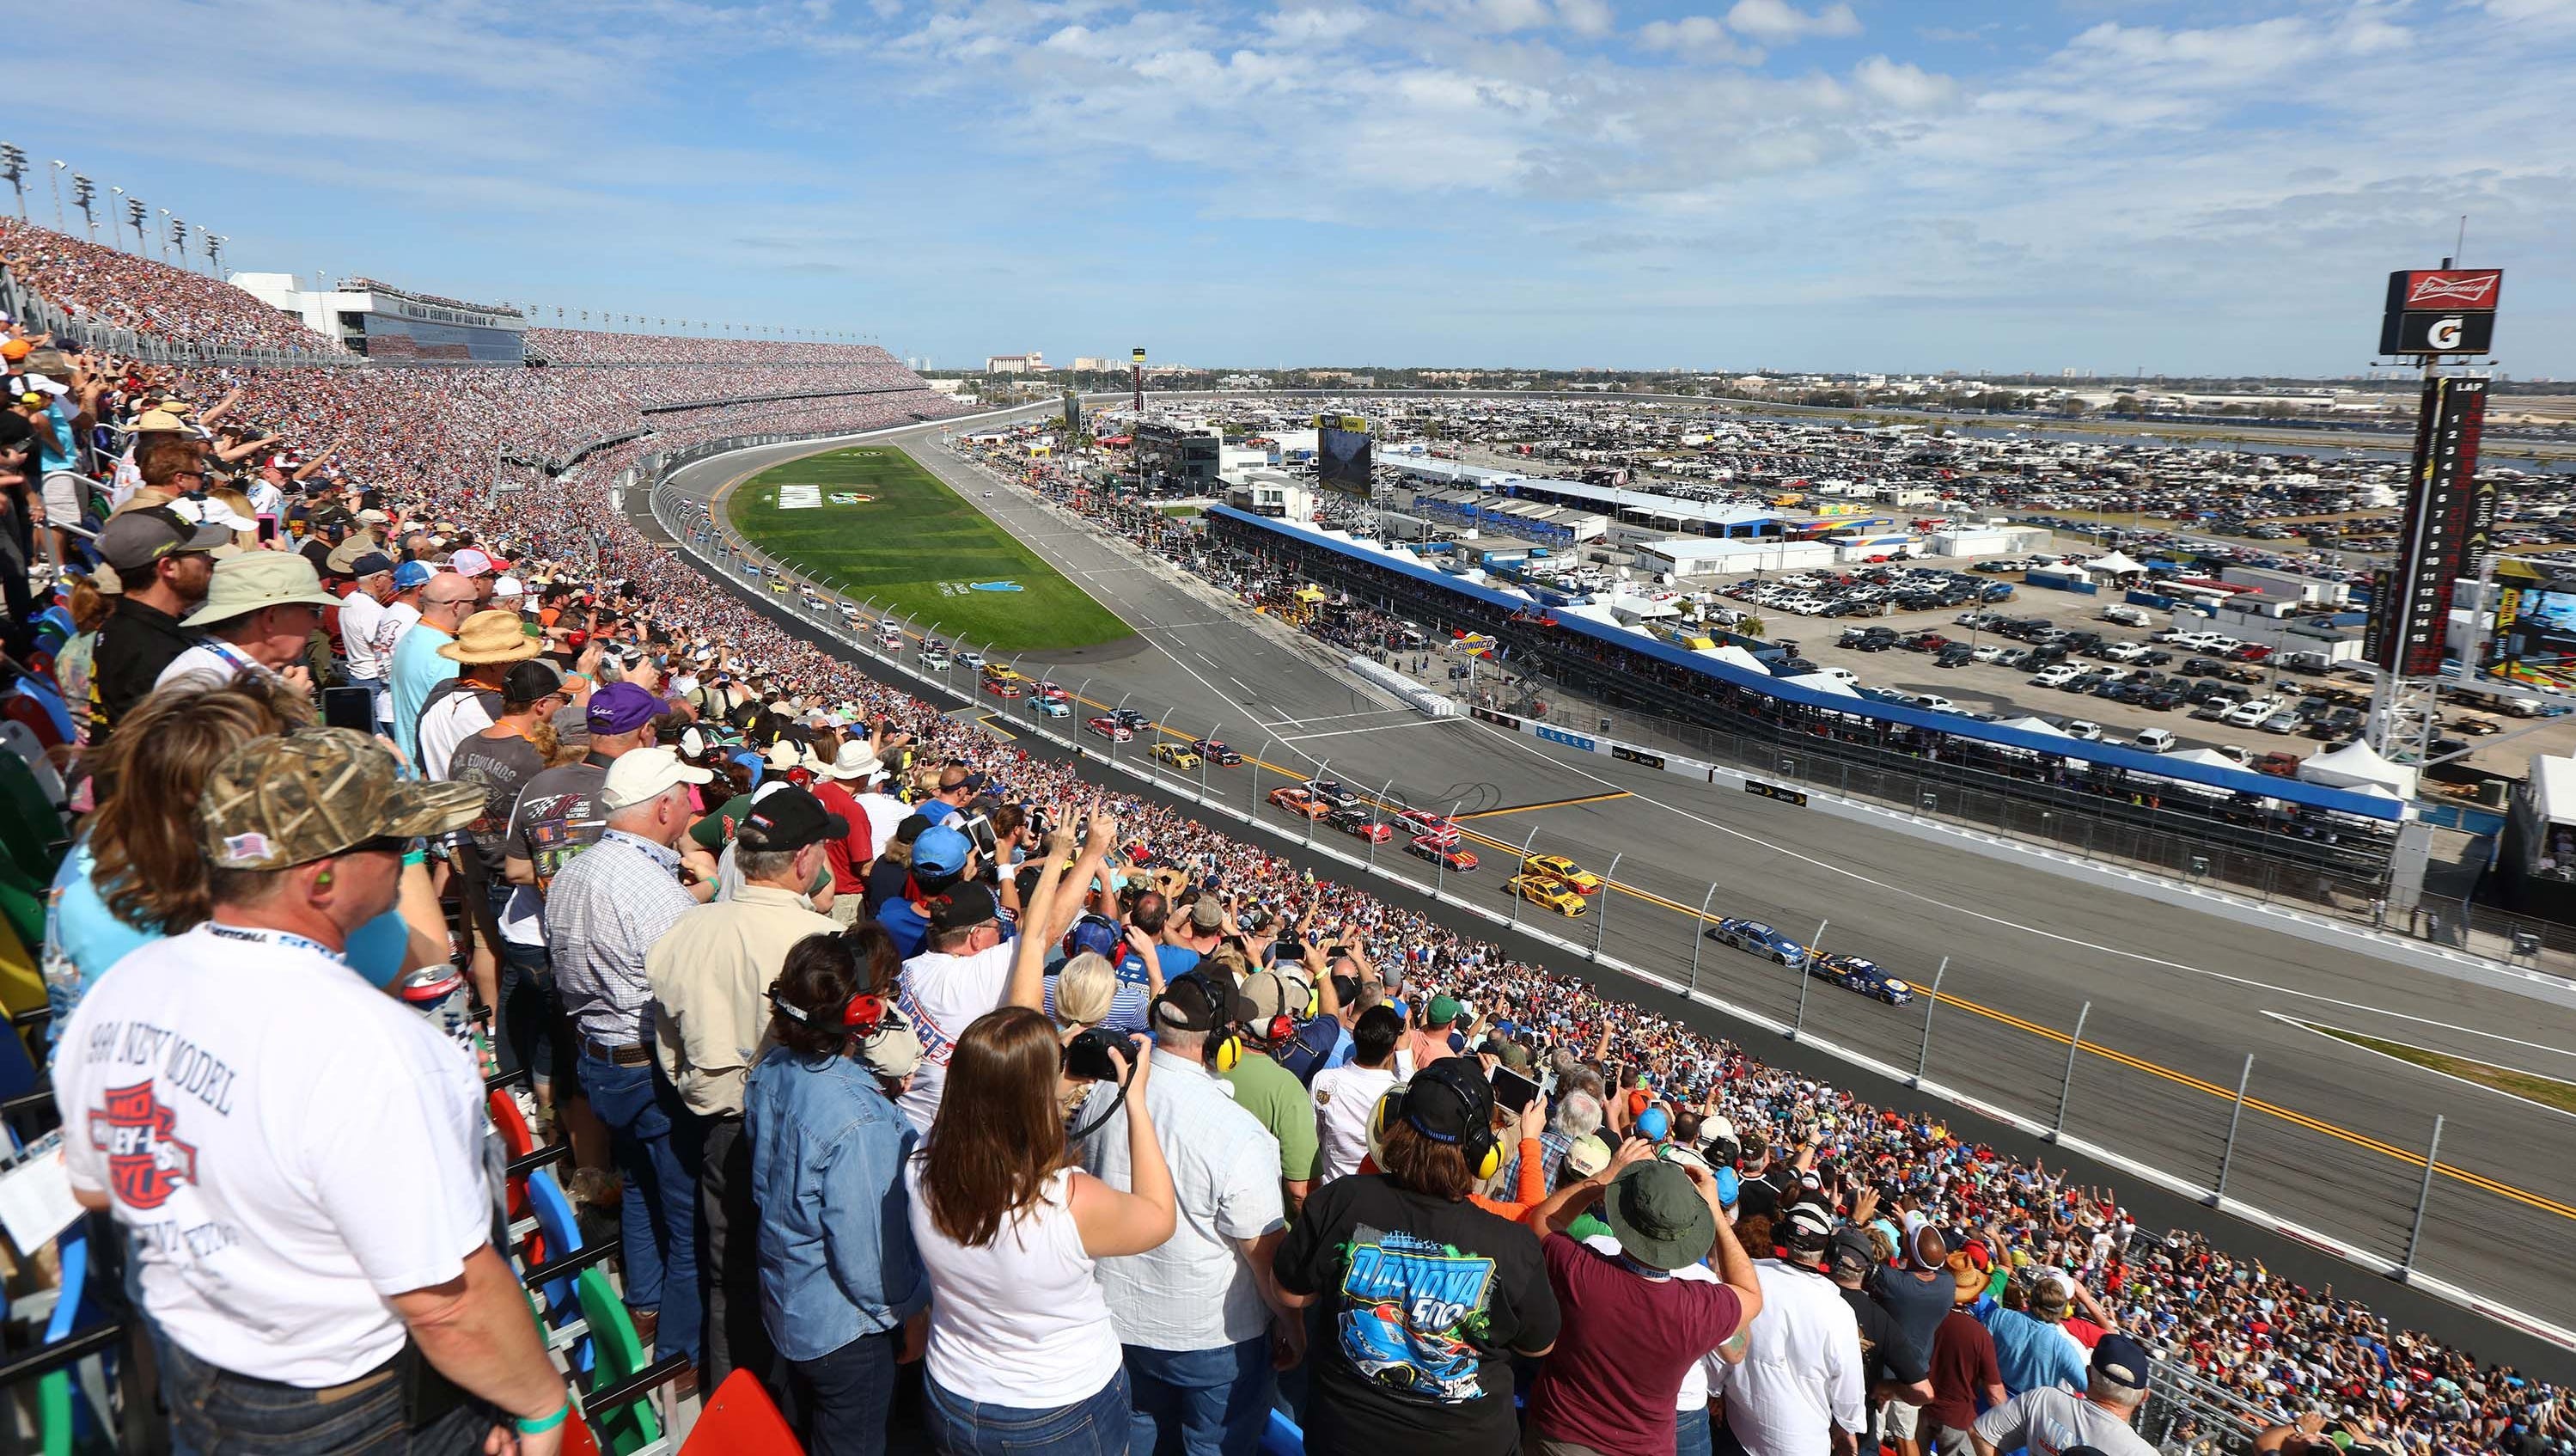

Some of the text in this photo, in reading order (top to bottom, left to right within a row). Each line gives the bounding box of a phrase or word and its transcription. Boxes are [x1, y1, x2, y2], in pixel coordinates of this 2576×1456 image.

[430, 309, 453, 321] CENTER
[464, 315, 486, 326] RACING
[2427, 315, 2463, 349] G
[2456, 382, 2483, 392] LAP
[2451, 414, 2459, 423] 1
[2447, 431, 2457, 439] 2
[2445, 446, 2455, 456] 3
[2442, 462, 2453, 471] 4
[2440, 478, 2450, 486] 5
[2437, 494, 2447, 503] 6
[2435, 510, 2445, 518] 7
[2474, 496, 2493, 528] Sprint
[2432, 525, 2442, 534] 8
[2429, 541, 2439, 550] 9
[2424, 557, 2440, 566] 10
[2466, 546, 2484, 576] Sprint
[2422, 572, 2436, 581] 11
[2420, 588, 2435, 596] 12
[2372, 586, 2385, 615] Sprint
[2417, 603, 2432, 612] 13
[1456, 639, 1494, 650] SUNOCO
[2364, 632, 2378, 659] Sprint
[1613, 749, 1627, 759] Sprint
[467, 753, 516, 782] EDWARDS
[1746, 784, 1762, 793] Sprint
[1778, 792, 1794, 801] Sprint
[1346, 824, 1355, 833] 41
[1416, 825, 1425, 835] 21
[1852, 976, 1865, 992] 24
[1346, 1247, 1491, 1308] DAYTONA
